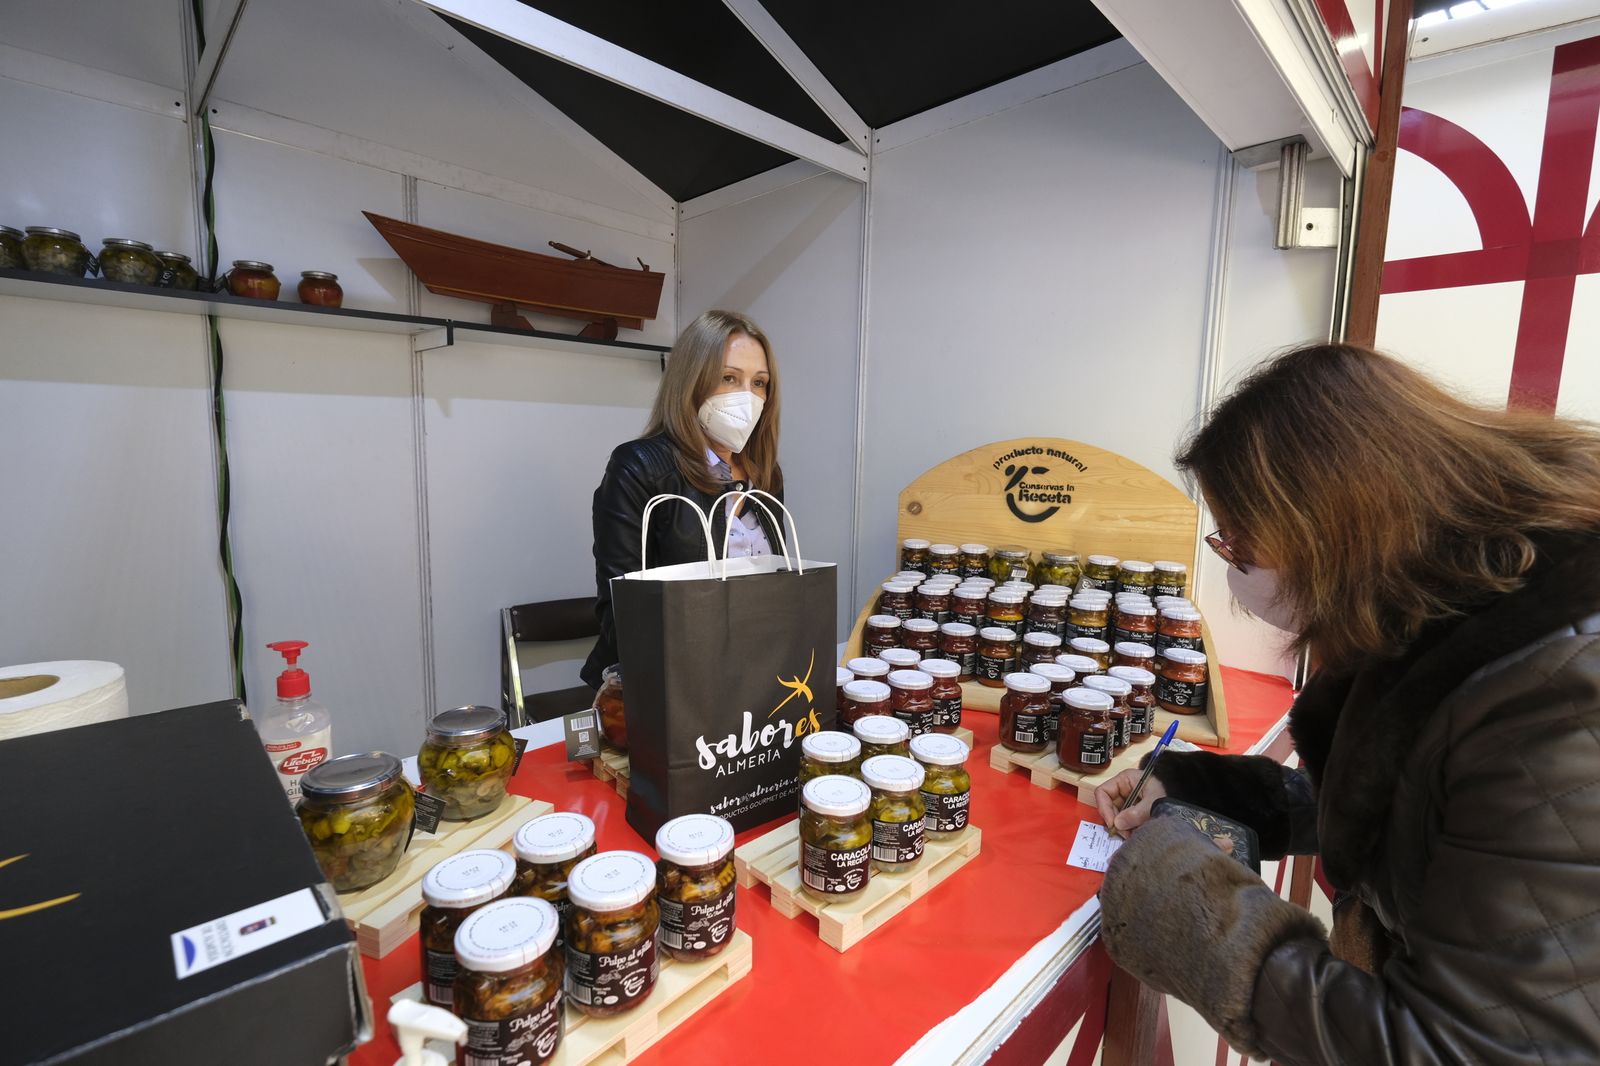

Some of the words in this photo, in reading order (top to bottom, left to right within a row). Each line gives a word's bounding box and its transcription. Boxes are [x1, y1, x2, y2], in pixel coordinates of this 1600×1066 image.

[992, 446, 1044, 470] producto
[1046, 448, 1088, 472] natural
[1019, 482, 1064, 491] Conservas
[1018, 490, 1071, 504] Receta
[696, 708, 822, 770] sabores
[283, 754, 324, 768] Lifebuoy
[716, 748, 781, 779] ALMERÍA
[750, 794, 778, 809] GOURMET
[779, 790, 786, 799] DE
[943, 792, 969, 804] CARACO
[830, 844, 871, 861] CARACOLA
[847, 854, 868, 867] RECETA
[690, 904, 715, 916] Pulpo
[598, 955, 626, 968] Pulpo
[509, 1014, 541, 1032] Pulpo
